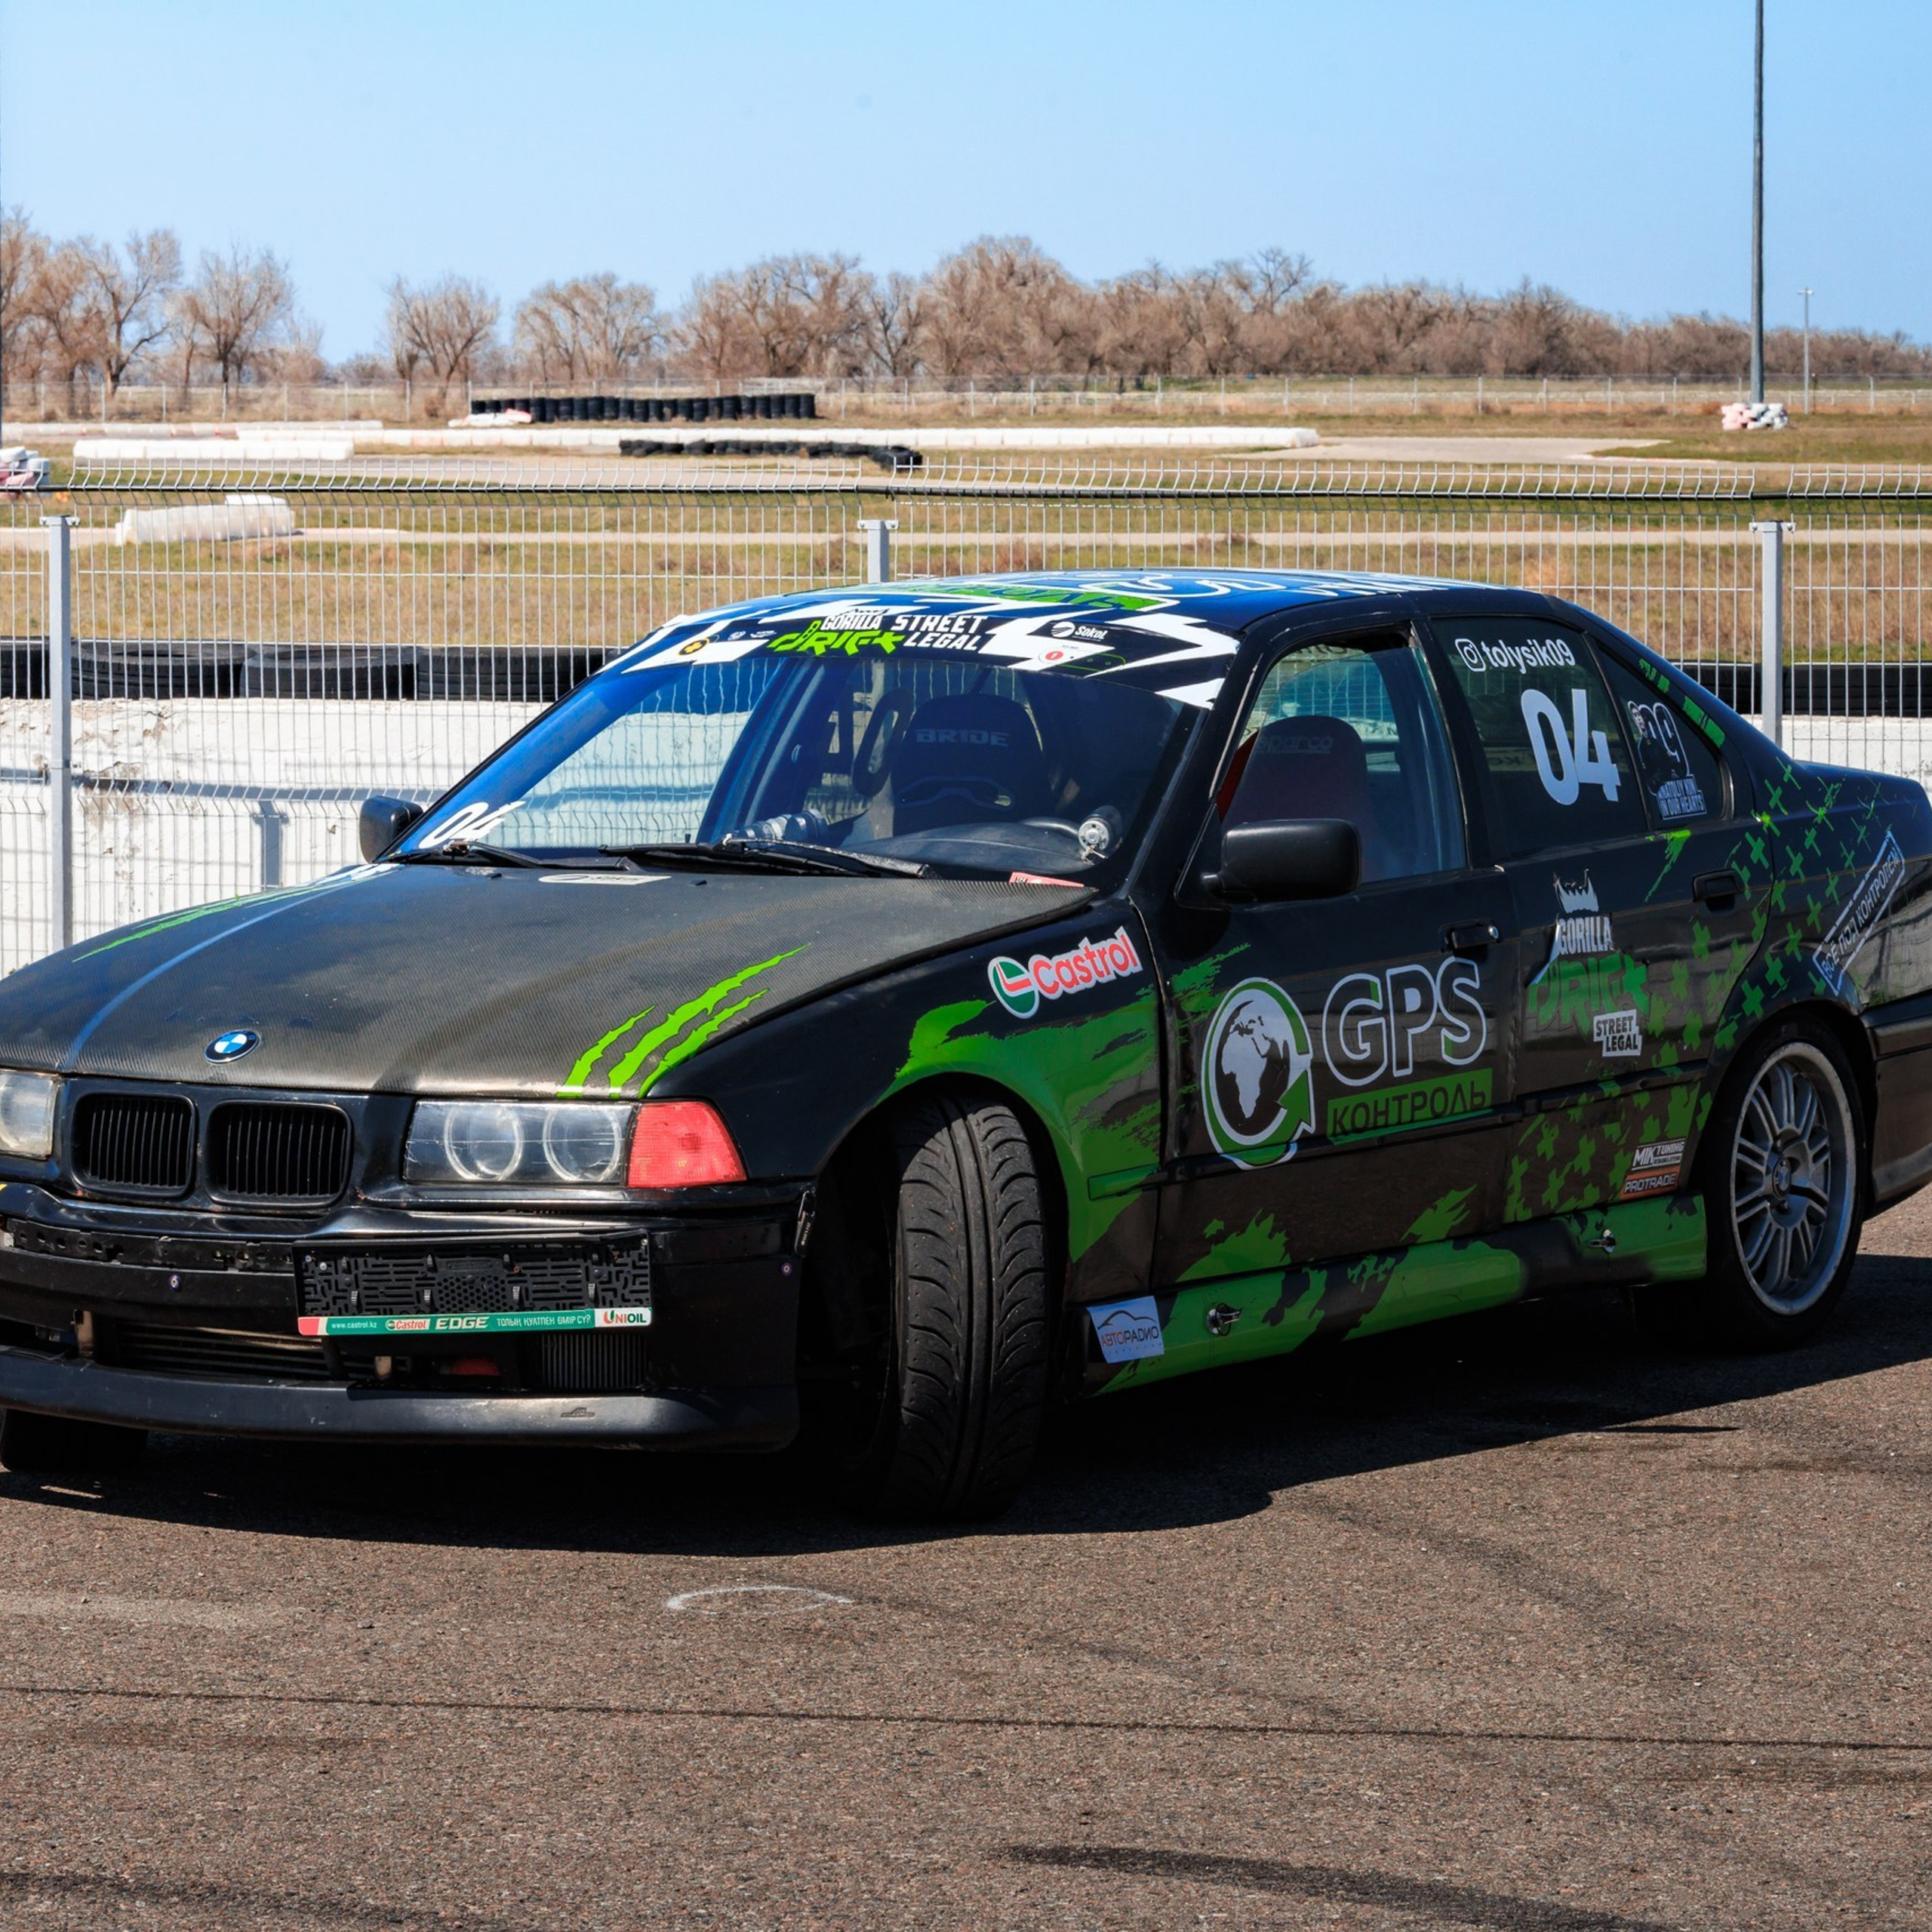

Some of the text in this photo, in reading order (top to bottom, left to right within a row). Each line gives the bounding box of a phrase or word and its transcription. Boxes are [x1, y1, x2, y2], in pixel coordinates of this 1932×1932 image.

[820, 614, 884, 631] GORILLA
[891, 614, 988, 633] STREET
[903, 632, 986, 651] LEGAL
[1481, 638, 1576, 674] tolysik09
[915, 729, 1009, 746] BRIDE
[1521, 688, 1621, 805] 04
[418, 801, 526, 848] 04
[1559, 916, 1614, 955] GORILLA
[1034, 932, 1138, 994] Castrol
[1323, 956, 1487, 1086] GPS
[1596, 1016, 1633, 1037] STREET
[1606, 1034, 1638, 1052] LEGAL
[1331, 1079, 1487, 1137] КОНТРОЛЬ
[1625, 1174, 1676, 1193] PROTRADE
[331, 1316, 490, 1331] www.castrol.kz Castrol EDGE
[603, 1310, 647, 1324] UNIOIL
[1103, 1326, 1159, 1347] АВТОРАДИО
